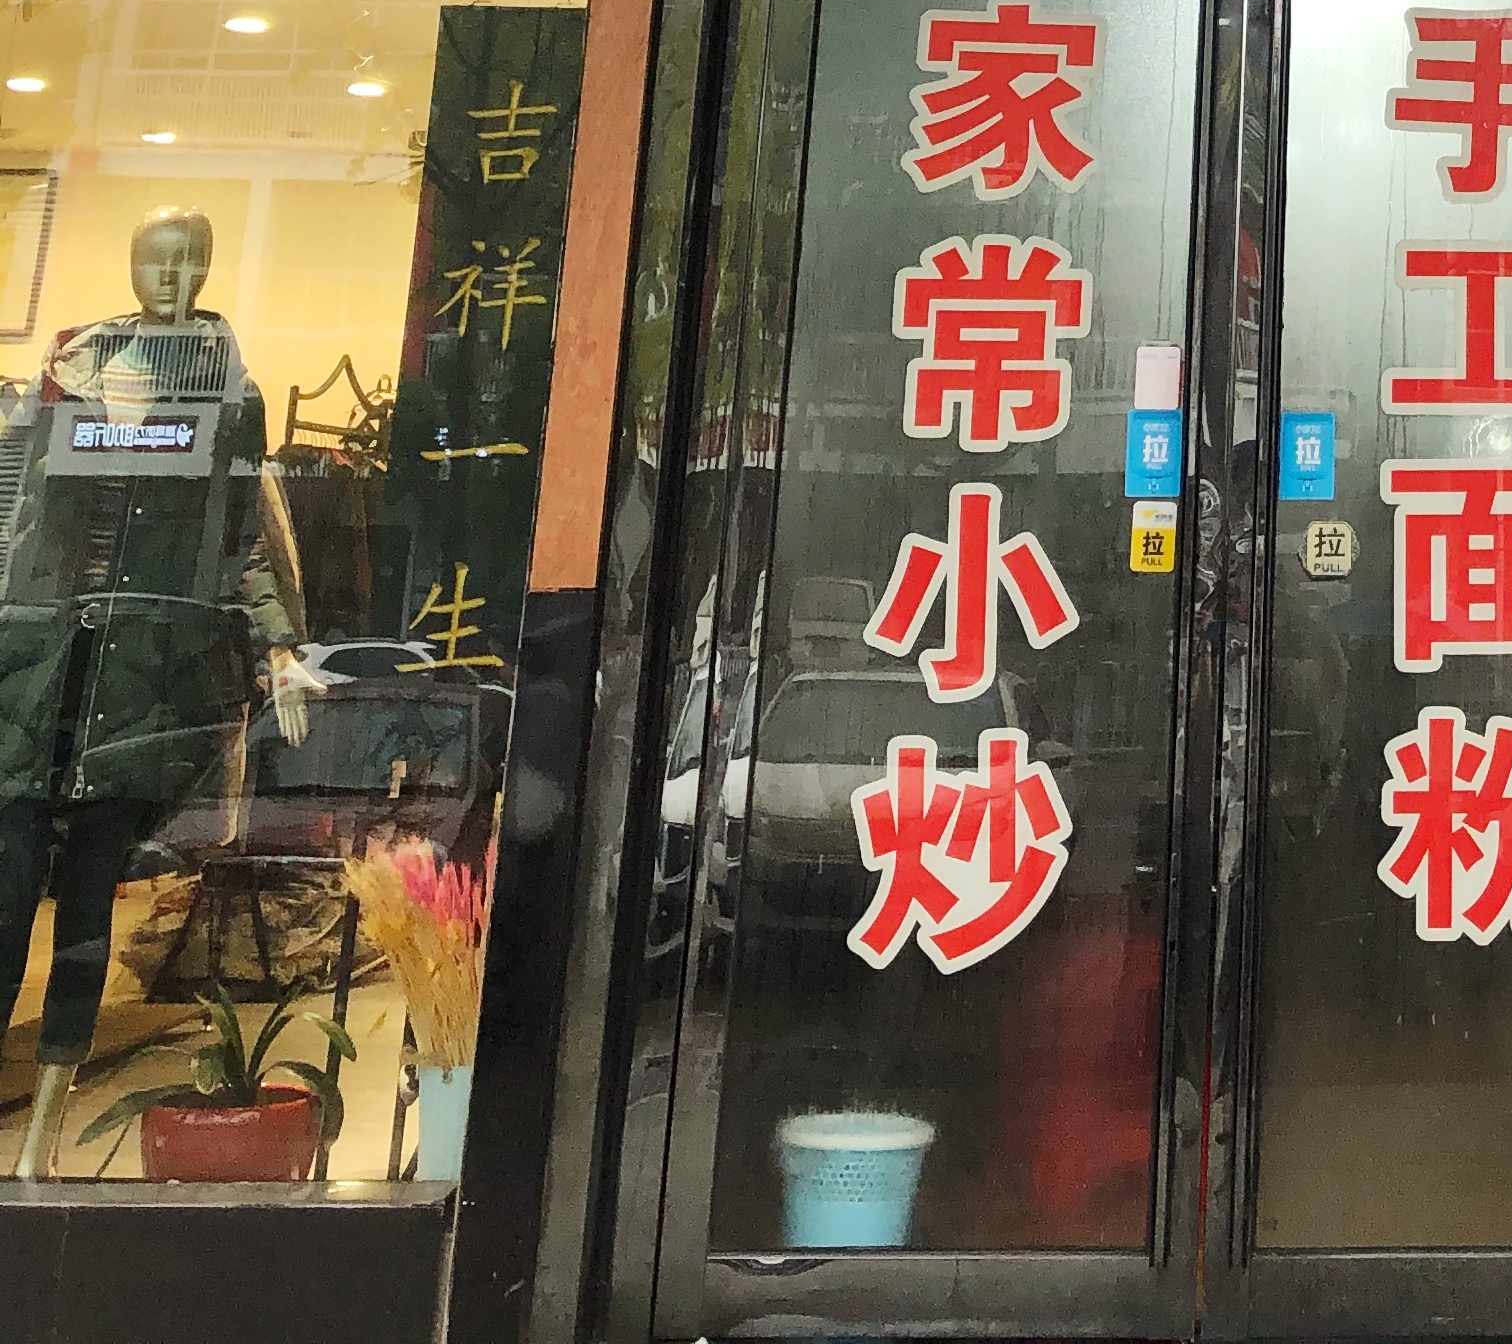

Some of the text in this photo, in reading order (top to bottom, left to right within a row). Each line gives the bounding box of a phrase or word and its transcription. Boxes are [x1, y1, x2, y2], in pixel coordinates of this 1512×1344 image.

[395, 80, 558, 673] 吉祥一生
[1143, 434, 1169, 463] 拉
[1296, 436, 1322, 465] 拉
[1142, 530, 1165, 556] 拉
[1313, 526, 1346, 558] 拉
[1140, 557, 1163, 567] PULL
[1313, 563, 1344, 573] PULL
